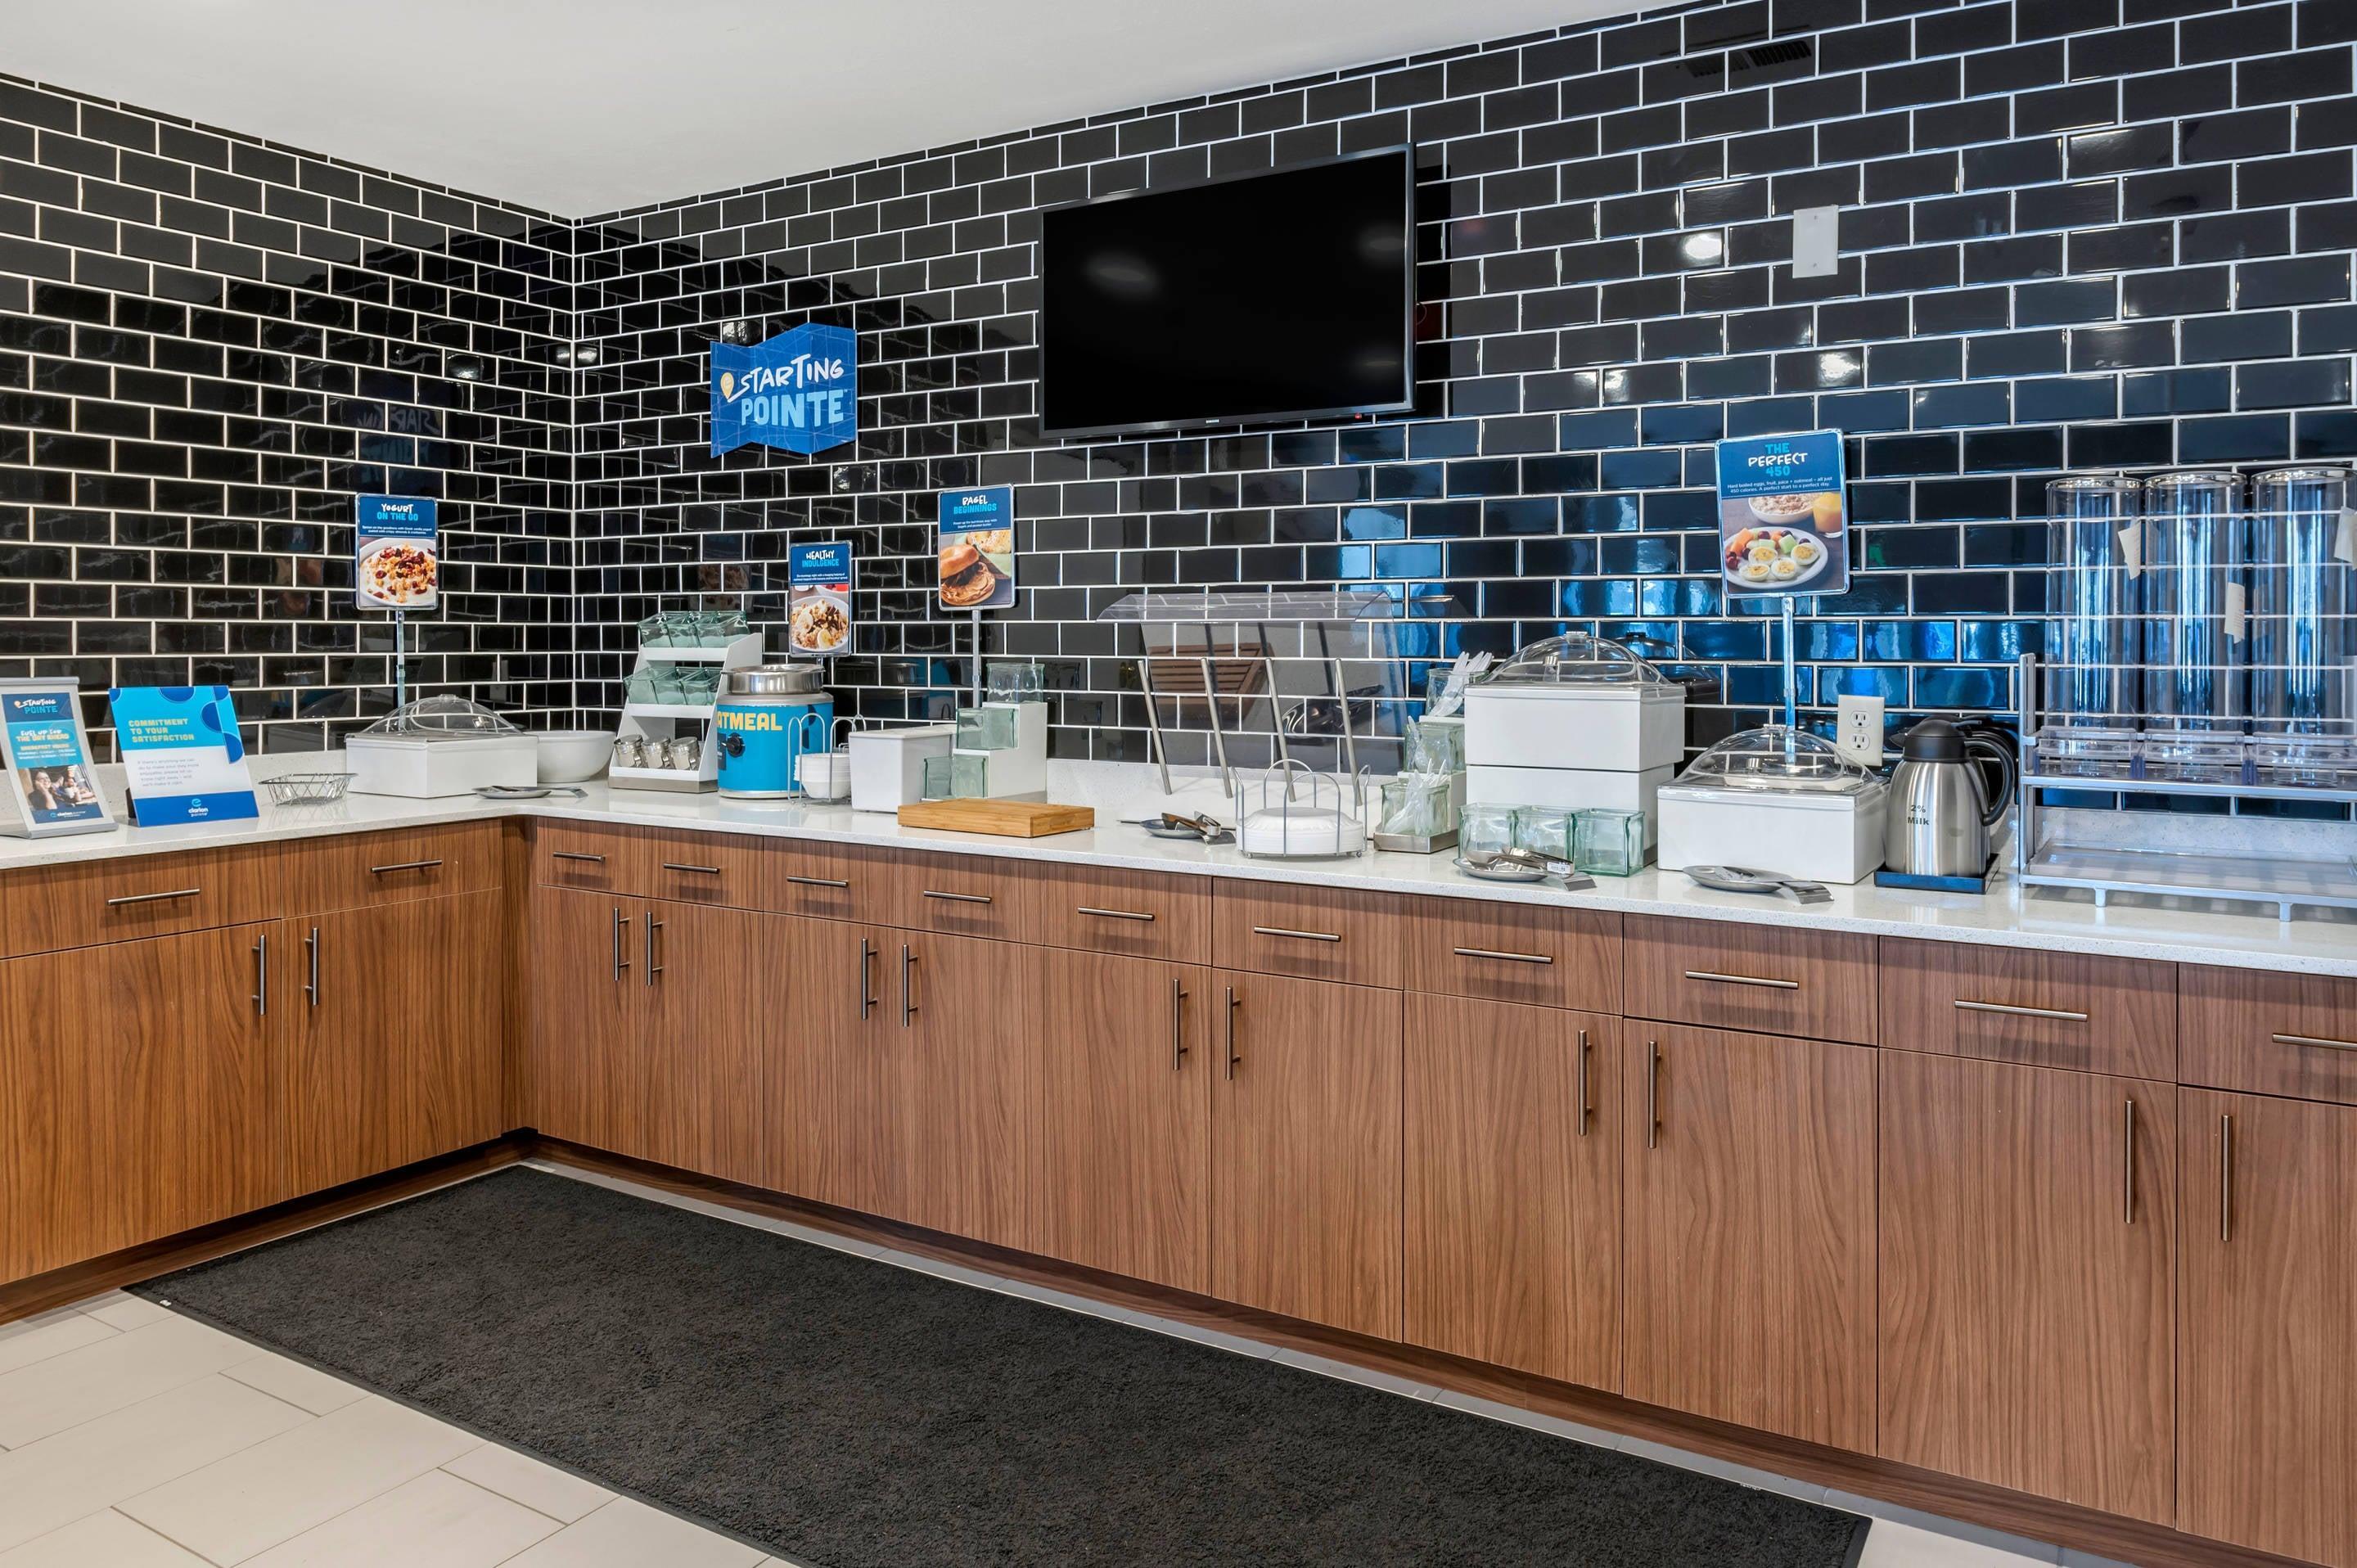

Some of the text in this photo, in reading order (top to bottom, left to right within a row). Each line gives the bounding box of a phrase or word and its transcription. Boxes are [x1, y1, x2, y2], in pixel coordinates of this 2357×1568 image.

[728, 354, 845, 403] STARTING
[741, 390, 844, 428] POINTE
[1764, 443, 1790, 454] THE
[1748, 453, 1808, 467] PERFECT
[1766, 466, 1791, 477] 450
[962, 494, 988, 506] BAGEL
[381, 503, 414, 514] YOGURT
[953, 502, 997, 515] BEGINNINGS
[376, 511, 418, 521] ON THE GO
[806, 549, 835, 560] HEALTHY
[802, 558, 840, 568] INDULGENCE
[25, 705, 58, 714] POINTE
[128, 718, 188, 728] COMMITMENT
[132, 734, 195, 742] SATISFACTION
[1911, 804, 1926, 813] 2%
[1908, 817, 1929, 826] Milk
